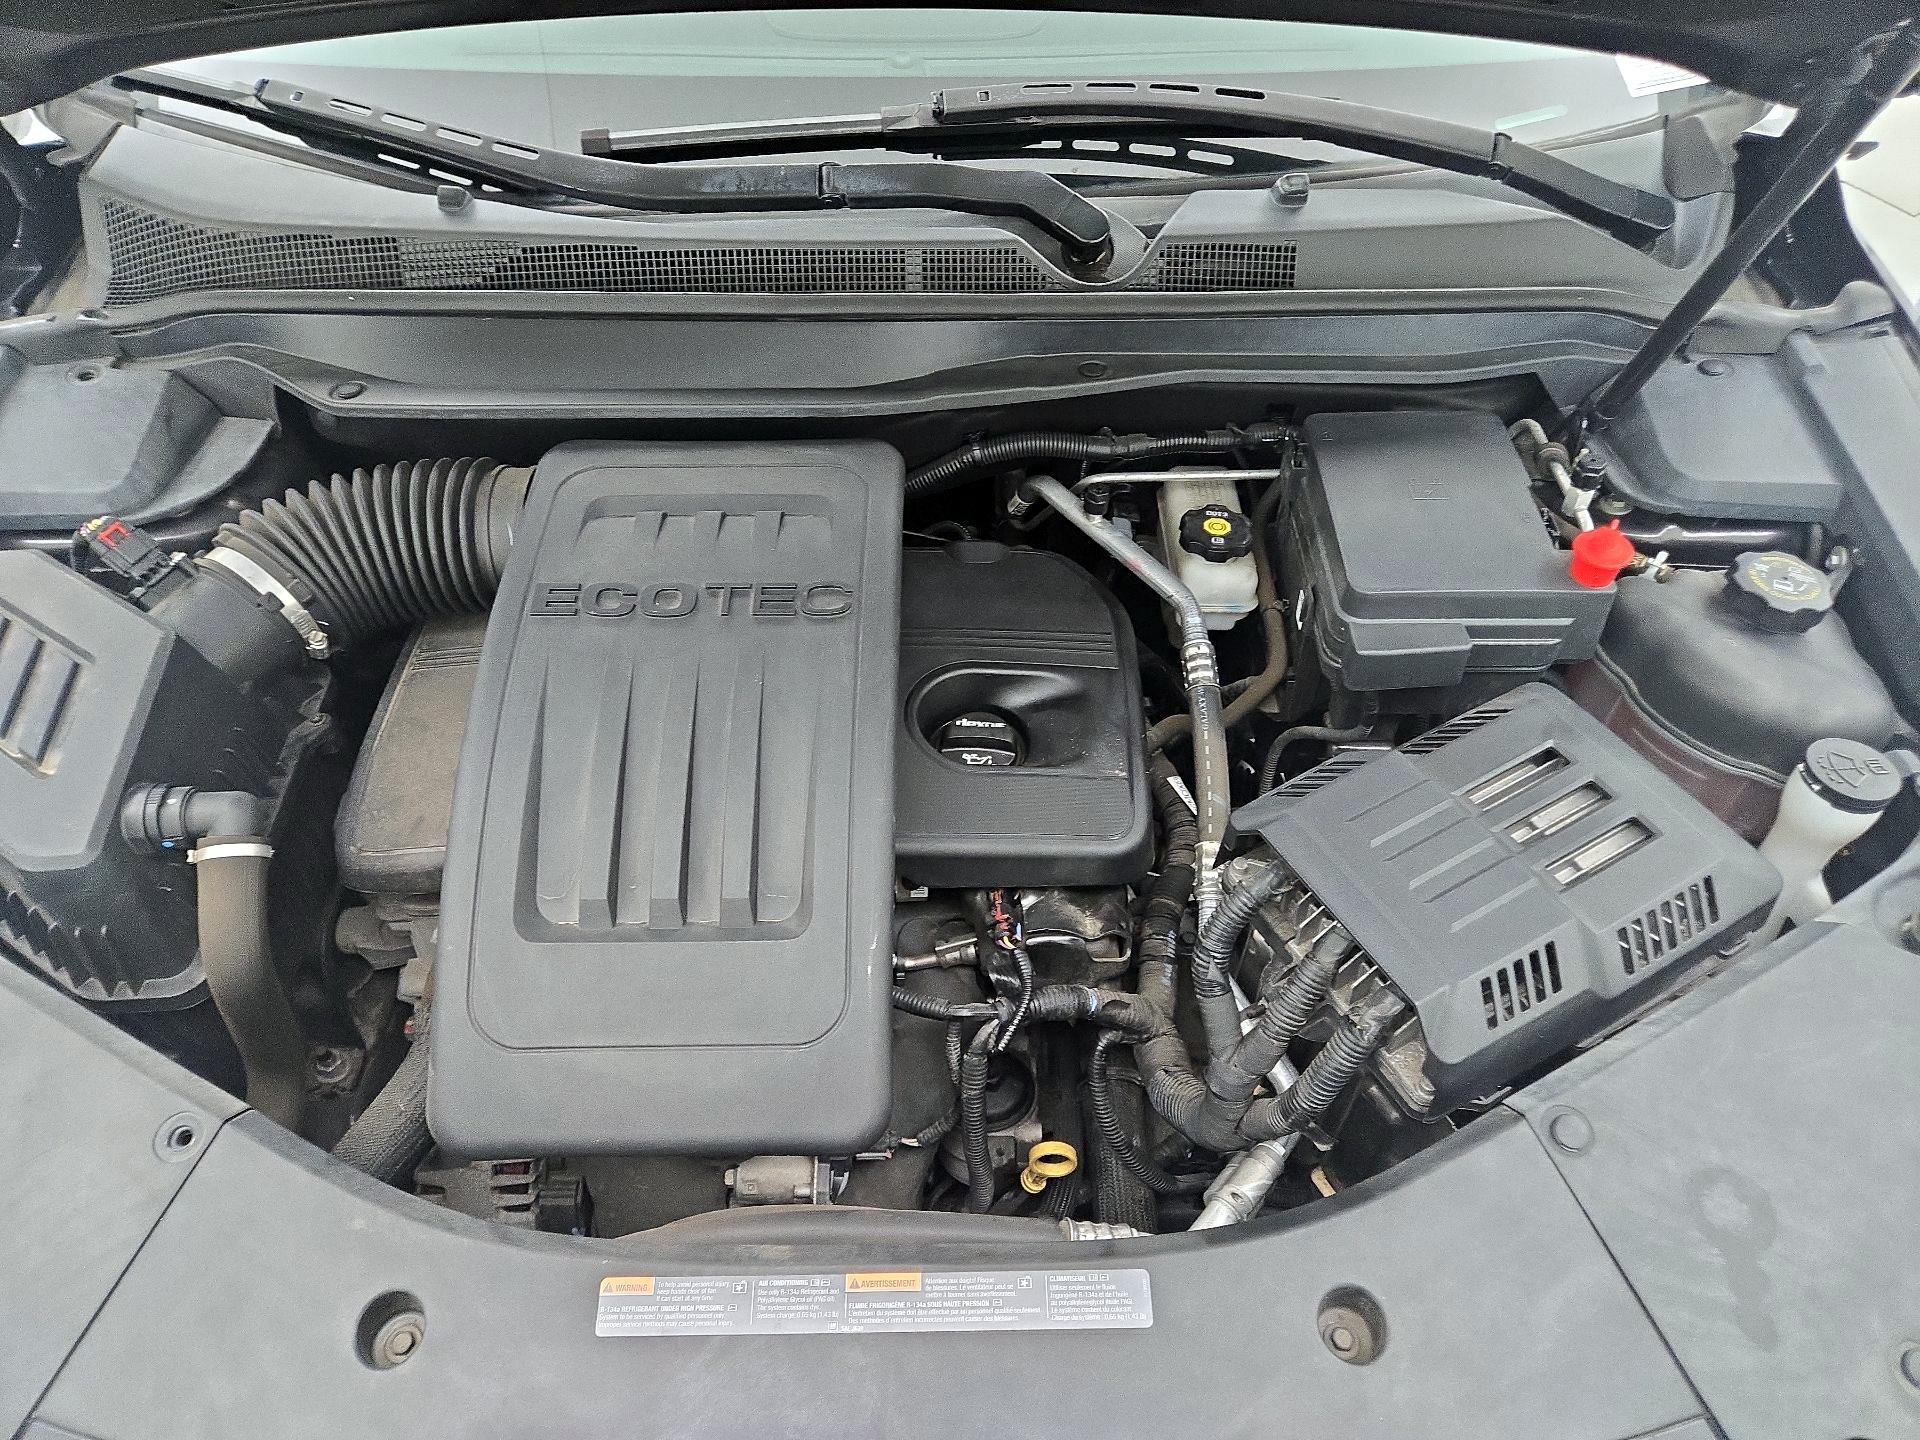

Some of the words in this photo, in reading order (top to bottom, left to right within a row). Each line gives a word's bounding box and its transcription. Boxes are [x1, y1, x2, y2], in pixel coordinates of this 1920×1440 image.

[530, 582, 853, 618] ECOTEC
[616, 1284, 648, 1292] WARNING
[861, 1280, 915, 1288] AVERTISSEMENT
